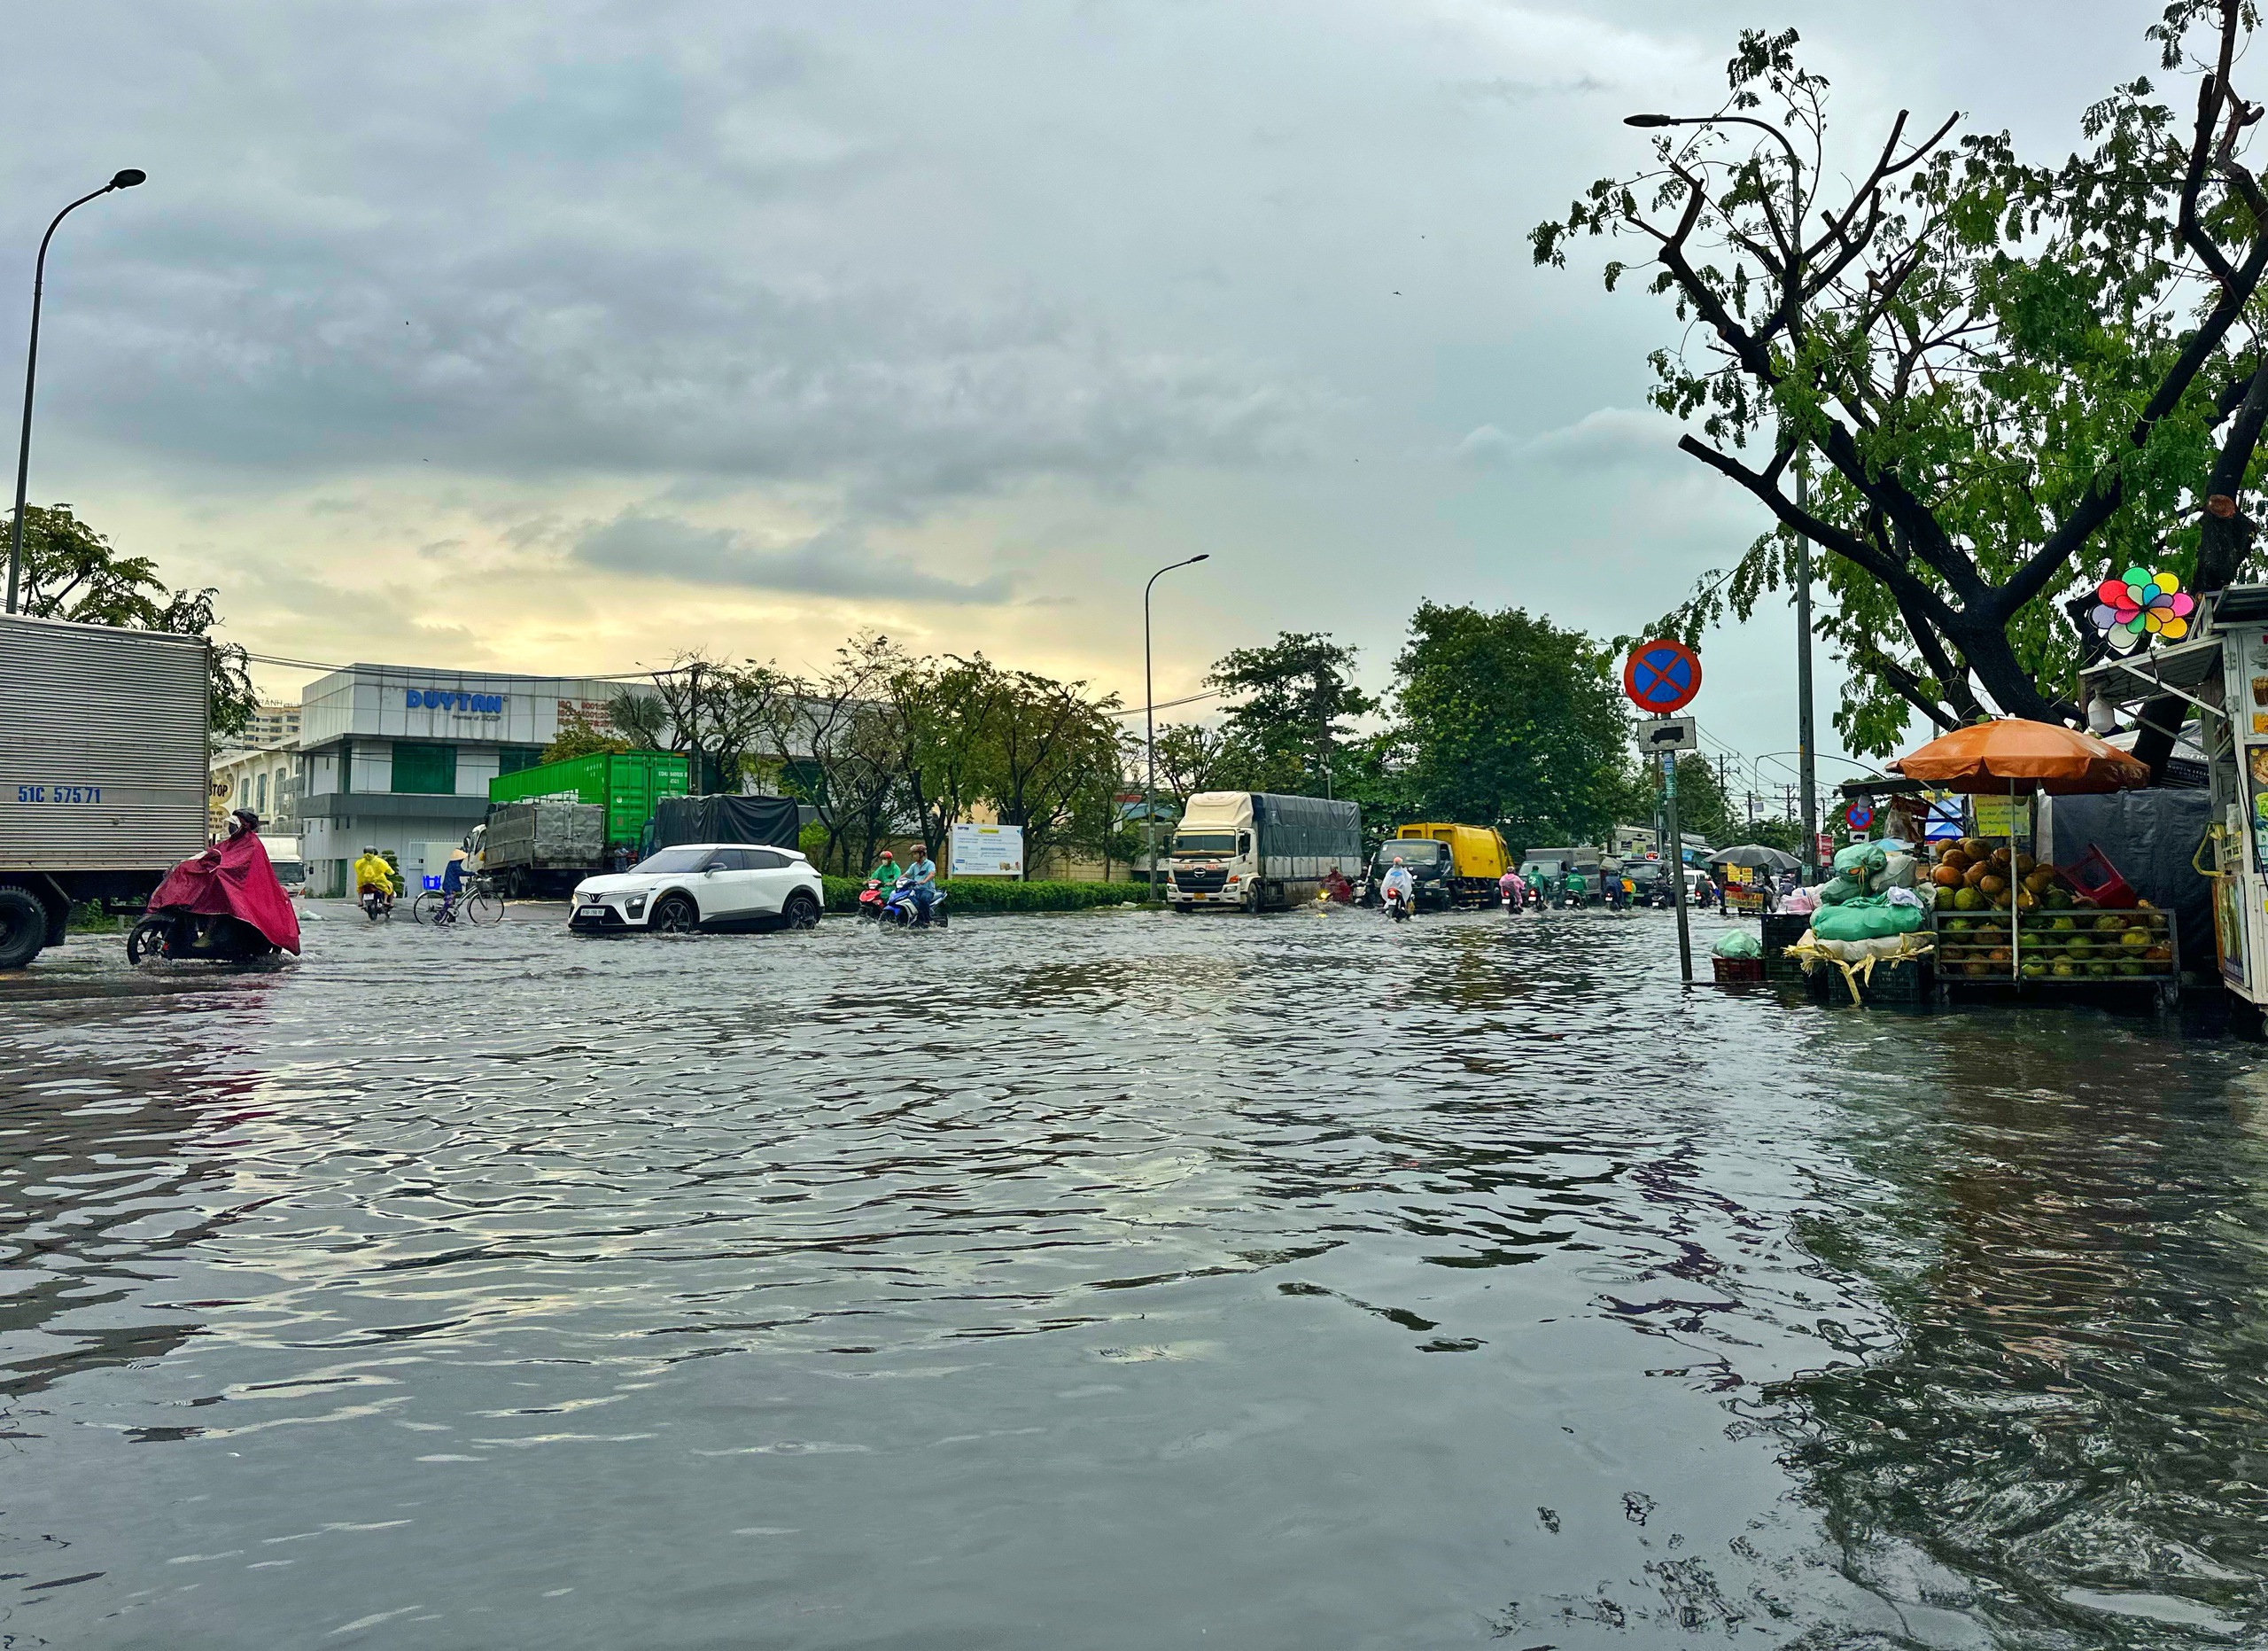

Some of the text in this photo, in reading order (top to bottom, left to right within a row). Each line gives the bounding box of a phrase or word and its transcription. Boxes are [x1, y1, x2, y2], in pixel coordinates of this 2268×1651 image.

[406, 689, 502, 713] DUYTAN
[18, 785, 101, 804] 51C 57571
[209, 784, 228, 797] STOP
